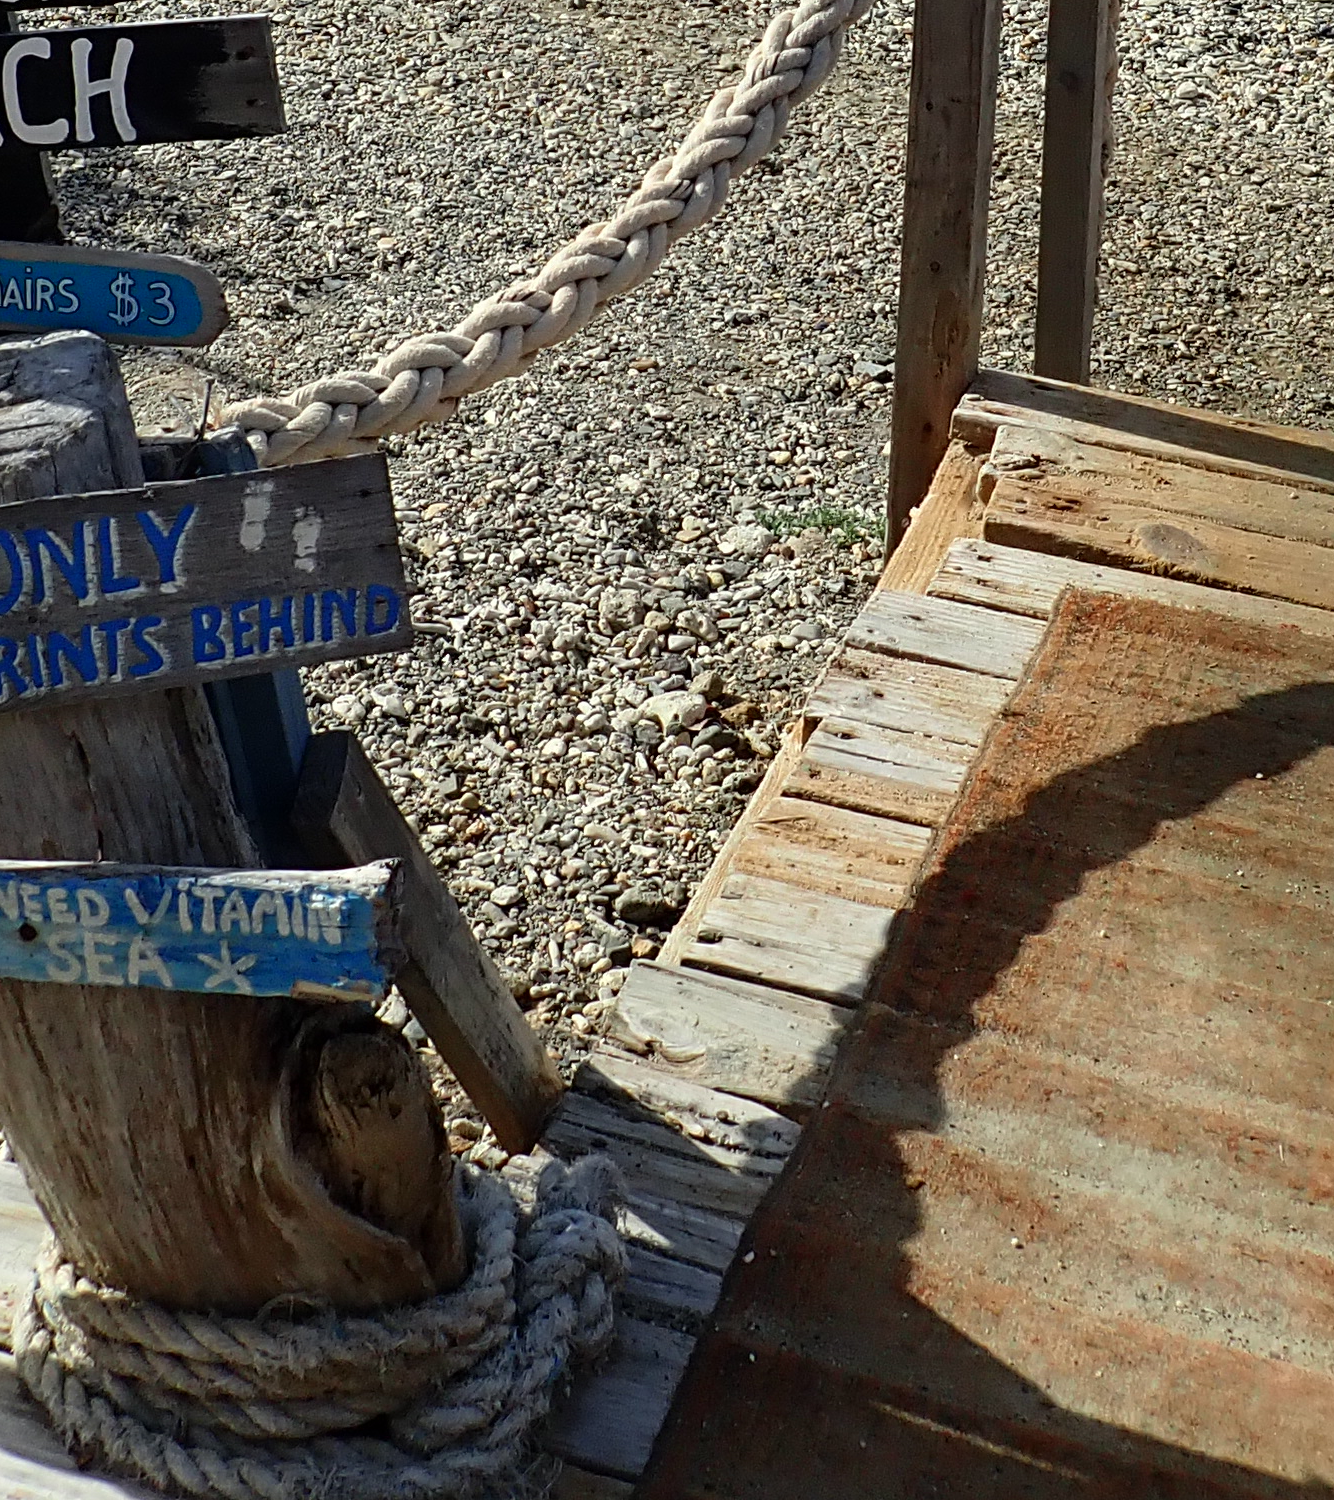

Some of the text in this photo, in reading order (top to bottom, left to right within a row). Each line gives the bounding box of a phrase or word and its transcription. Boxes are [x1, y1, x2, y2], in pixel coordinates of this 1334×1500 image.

[107, 271, 176, 327] $3
[190, 583, 401, 669] BEHIND
[44, 929, 174, 988] SEA
